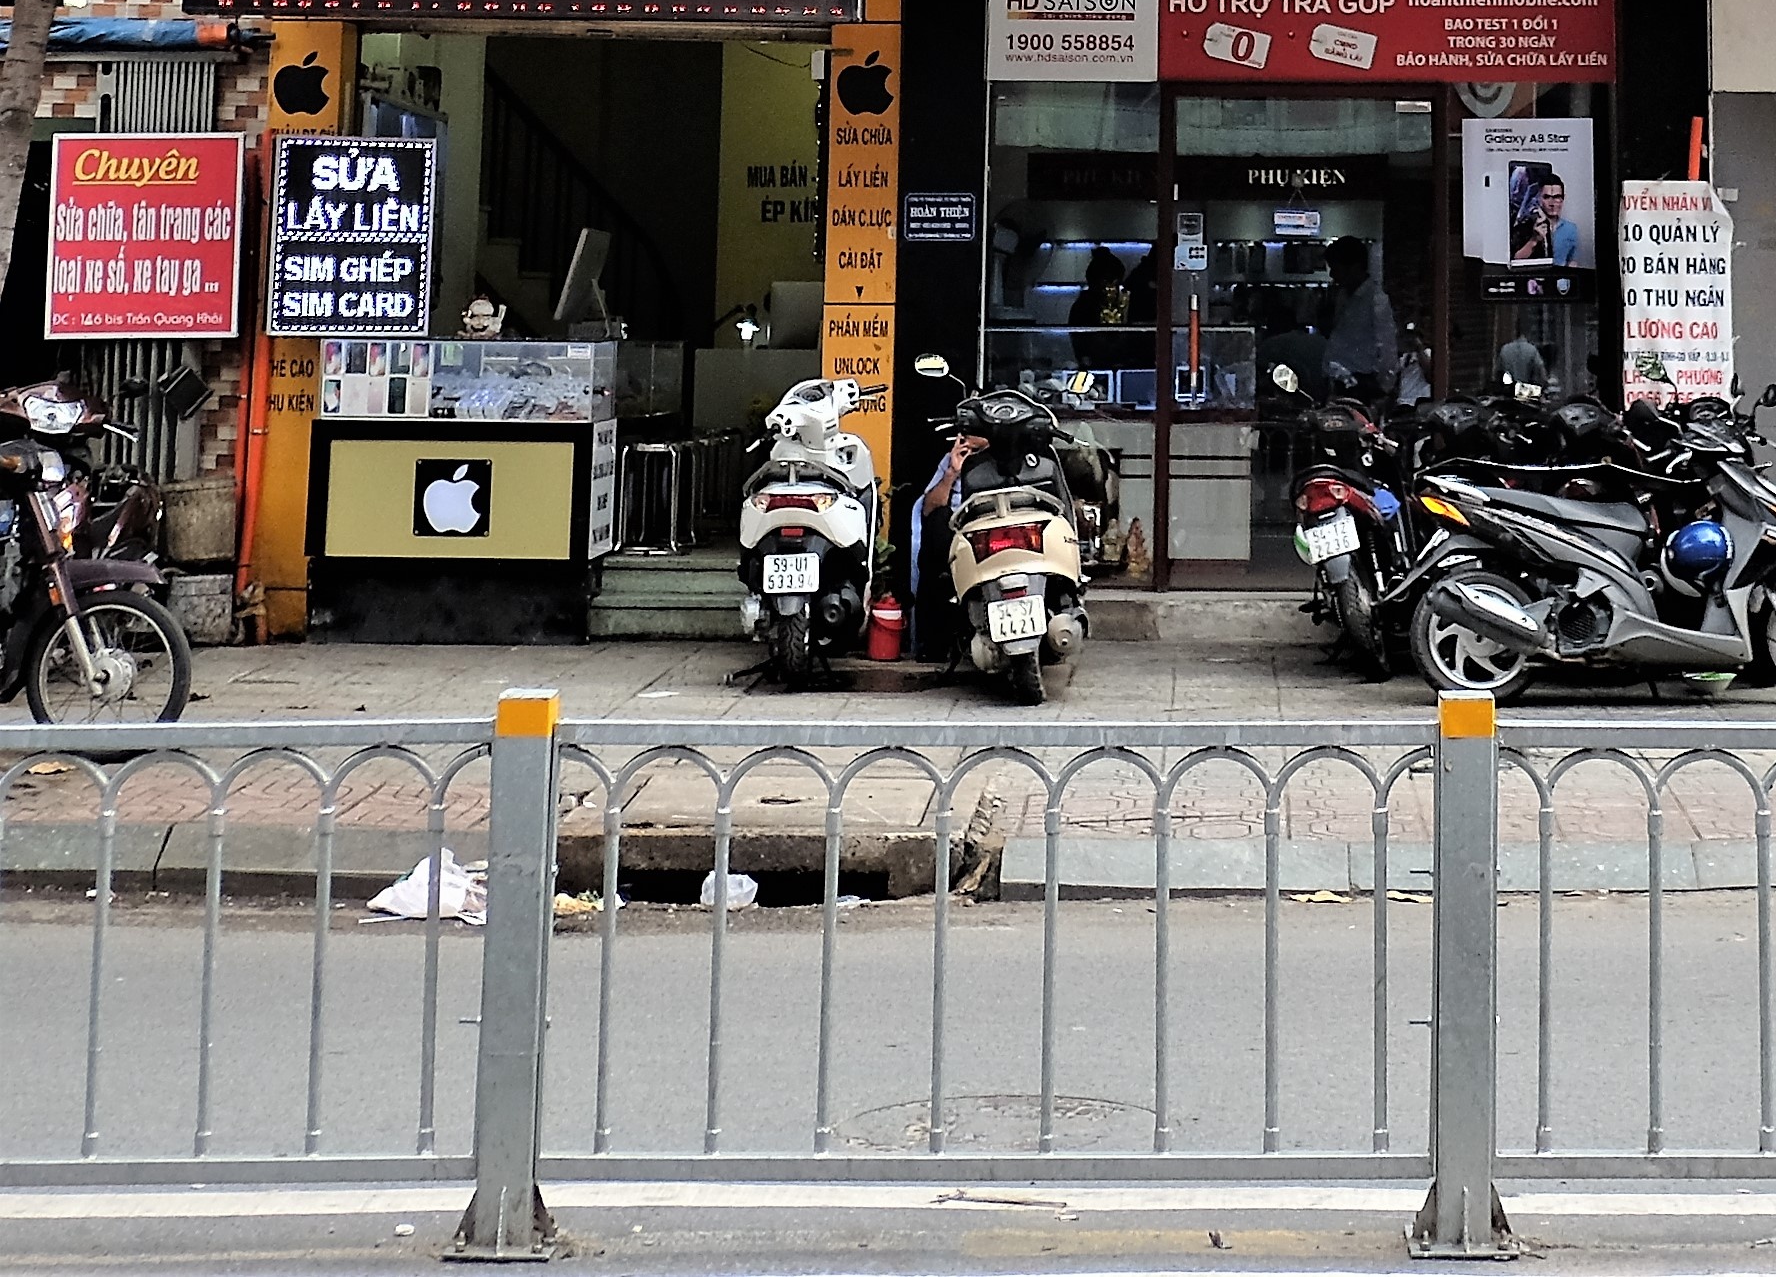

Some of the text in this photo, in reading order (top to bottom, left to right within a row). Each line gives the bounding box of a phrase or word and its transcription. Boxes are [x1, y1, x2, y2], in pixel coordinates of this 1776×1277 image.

[1444, 19, 1474, 31] BAO
[1477, 19, 1509, 31] TEST
[1522, 14, 1550, 31] ĐỔI
[1005, 33, 1135, 52] 1900 558854
[1231, 30, 1255, 62] 0
[1447, 32, 1557, 49] TRONG 30 NGÀY
[1004, 53, 1134, 63] www.hdsaison.com.vn
[1396, 51, 1427, 67] BẢO
[1428, 50, 1473, 68] HÀNH,
[1475, 51, 1506, 67] SỬA
[1507, 51, 1547, 67] CHỮA
[1549, 50, 1577, 67] LẤY
[836, 121, 893, 146] SỬA CHỮA
[1484, 134, 1571, 147] Galaxy Star
[73, 148, 200, 187] Chuyên
[311, 147, 401, 192] SỬA
[747, 159, 808, 189] MUA BÁN
[838, 163, 862, 188] LẤY
[1247, 166, 1346, 188] PHỤ KIỆN
[56, 196, 232, 244] Sửa chữa, tân trang các
[286, 195, 349, 232] LẤY
[760, 195, 786, 223] ÉP
[832, 205, 856, 228] DÁN
[1623, 217, 1721, 246] 10 QUẢN LÝ
[283, 250, 415, 283] SIM GHÉP
[838, 248, 883, 273] CÀI ĐẶT
[1643, 252, 1726, 276] BÁN HÀNG
[53, 245, 201, 302] loại xe số, xe tay ga
[281, 291, 415, 318] SIM CARD
[1643, 288, 1678, 308] THU
[80, 312, 193, 327] 146 bis Quang
[829, 313, 889, 337] PHẦN MỀM
[1626, 317, 1718, 340] LƯƠNG CAO
[834, 357, 880, 375] UNLOCK
